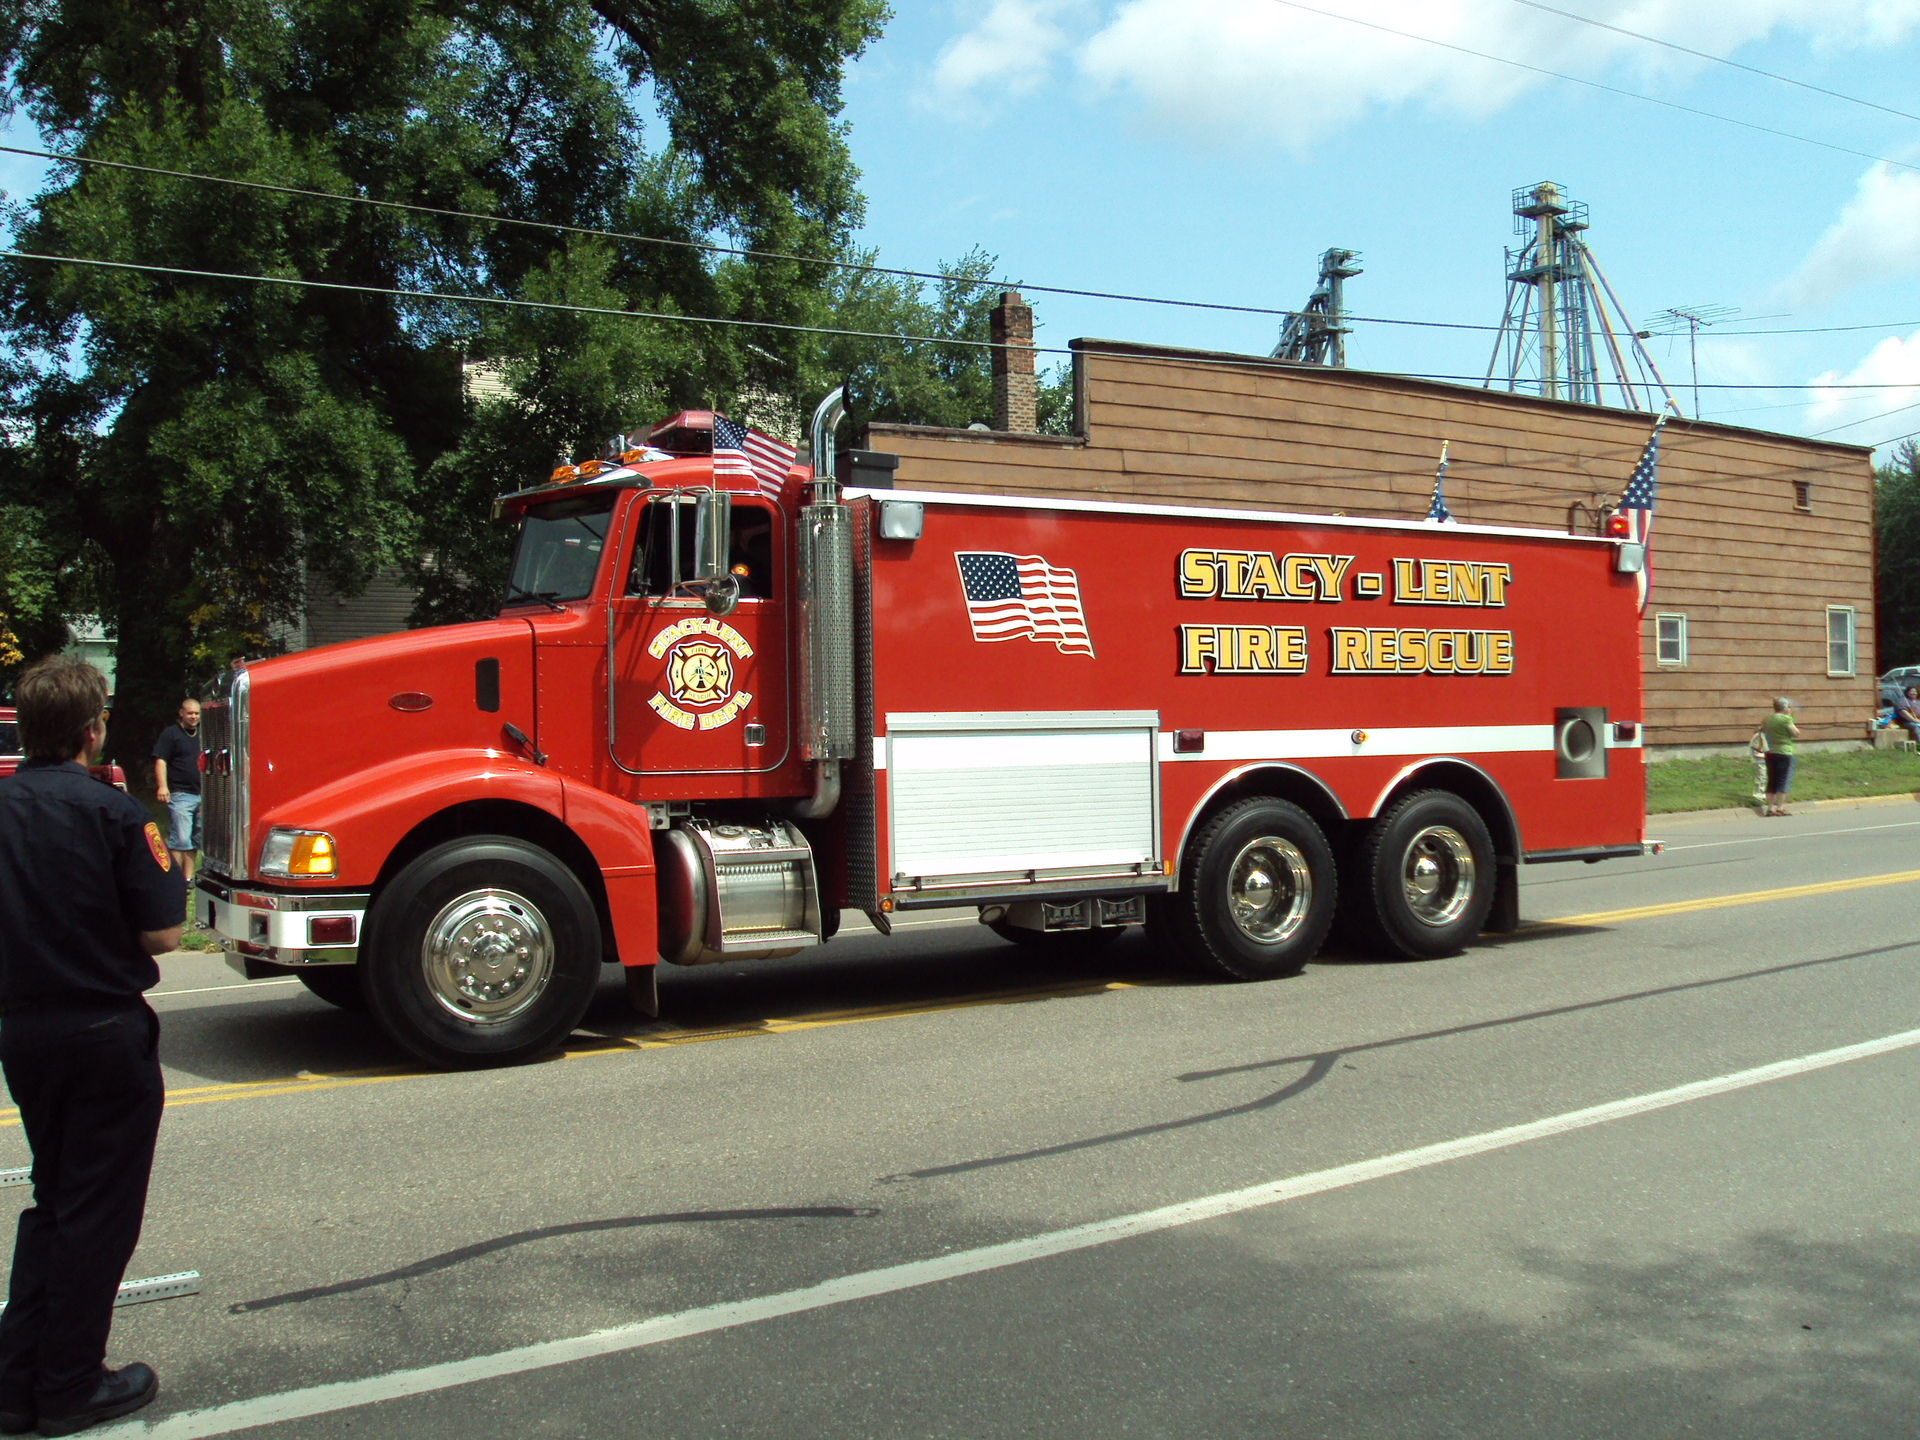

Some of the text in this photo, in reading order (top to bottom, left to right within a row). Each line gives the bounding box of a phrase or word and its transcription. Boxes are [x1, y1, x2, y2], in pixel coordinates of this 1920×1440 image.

[1179, 548, 1355, 602] STACY
[1393, 558, 1511, 606] LENT
[648, 617, 754, 660] STACY-LENT
[691, 646, 709, 654] FIRE
[1180, 623, 1513, 674] FIRE RESCUE
[647, 690, 754, 730] FIRE DEPT.
